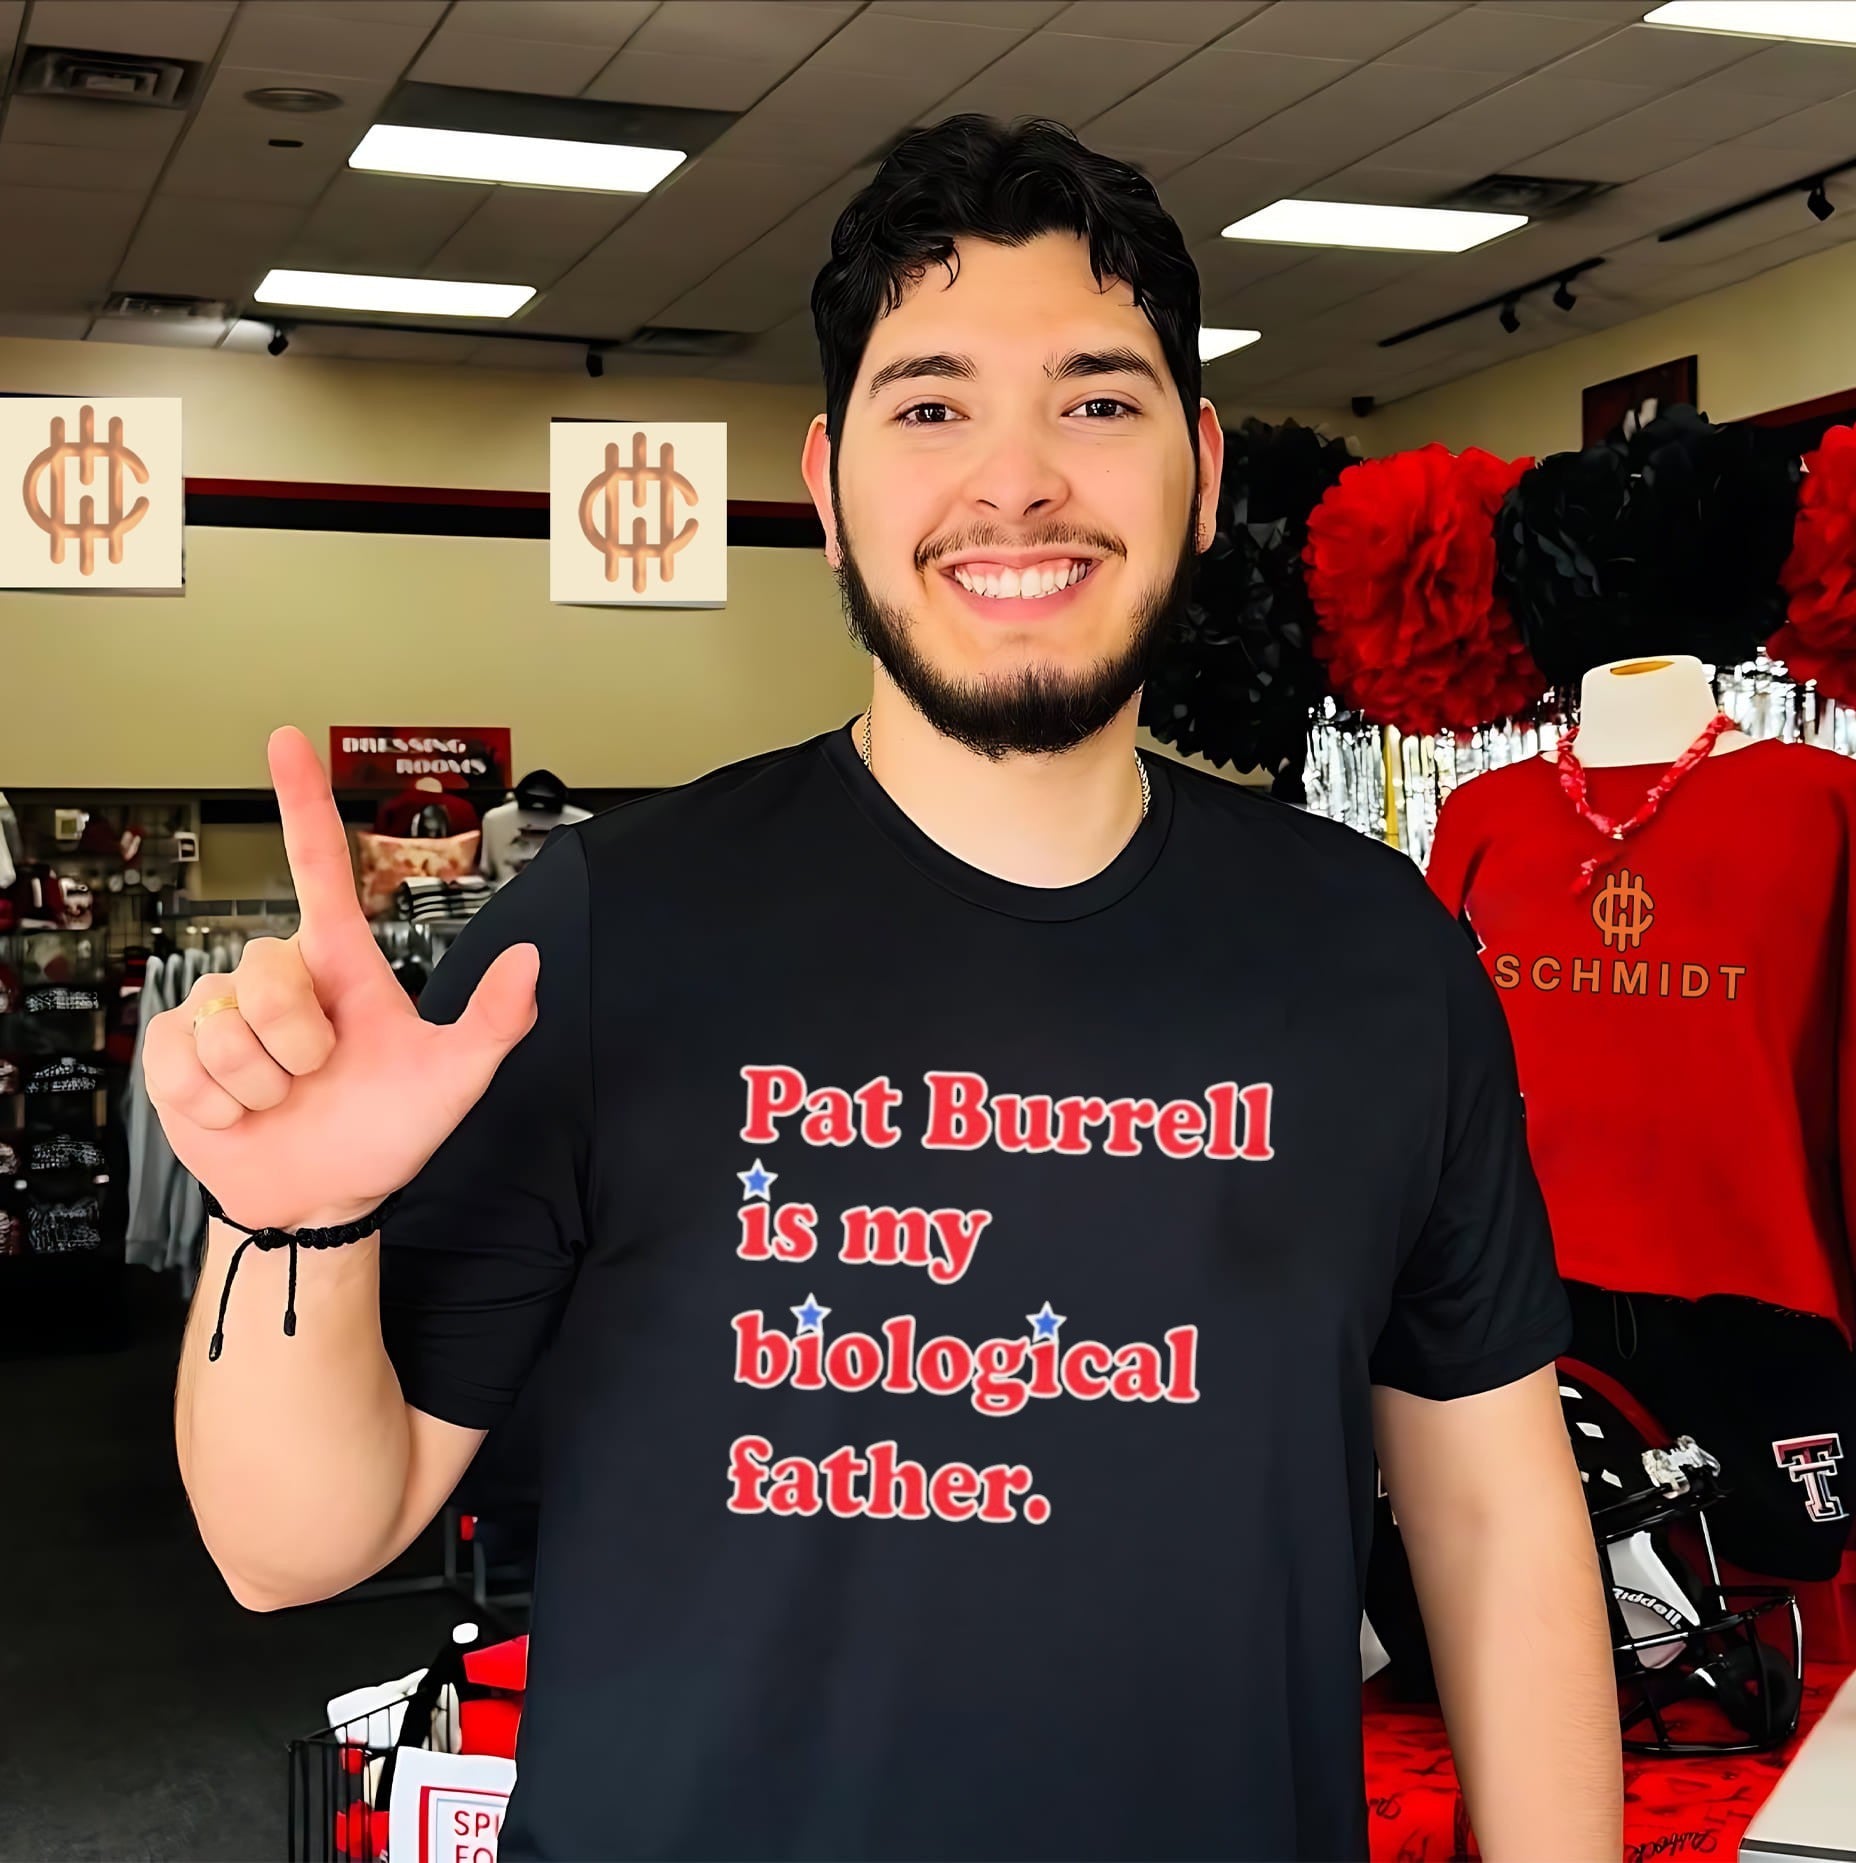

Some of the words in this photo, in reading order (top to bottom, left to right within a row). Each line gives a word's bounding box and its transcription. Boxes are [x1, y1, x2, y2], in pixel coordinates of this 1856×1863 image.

[342, 737, 467, 754] DRESSING
[396, 758, 487, 775] ROOMS
[1494, 953, 1747, 1000] SCHMIDT
[739, 1064, 904, 1149] Pat
[920, 1070, 1276, 1162] Burrell
[735, 1160, 819, 1263] is
[837, 1203, 994, 1286] my
[730, 1293, 1202, 1418] biological
[726, 1434, 1053, 1526] father.
